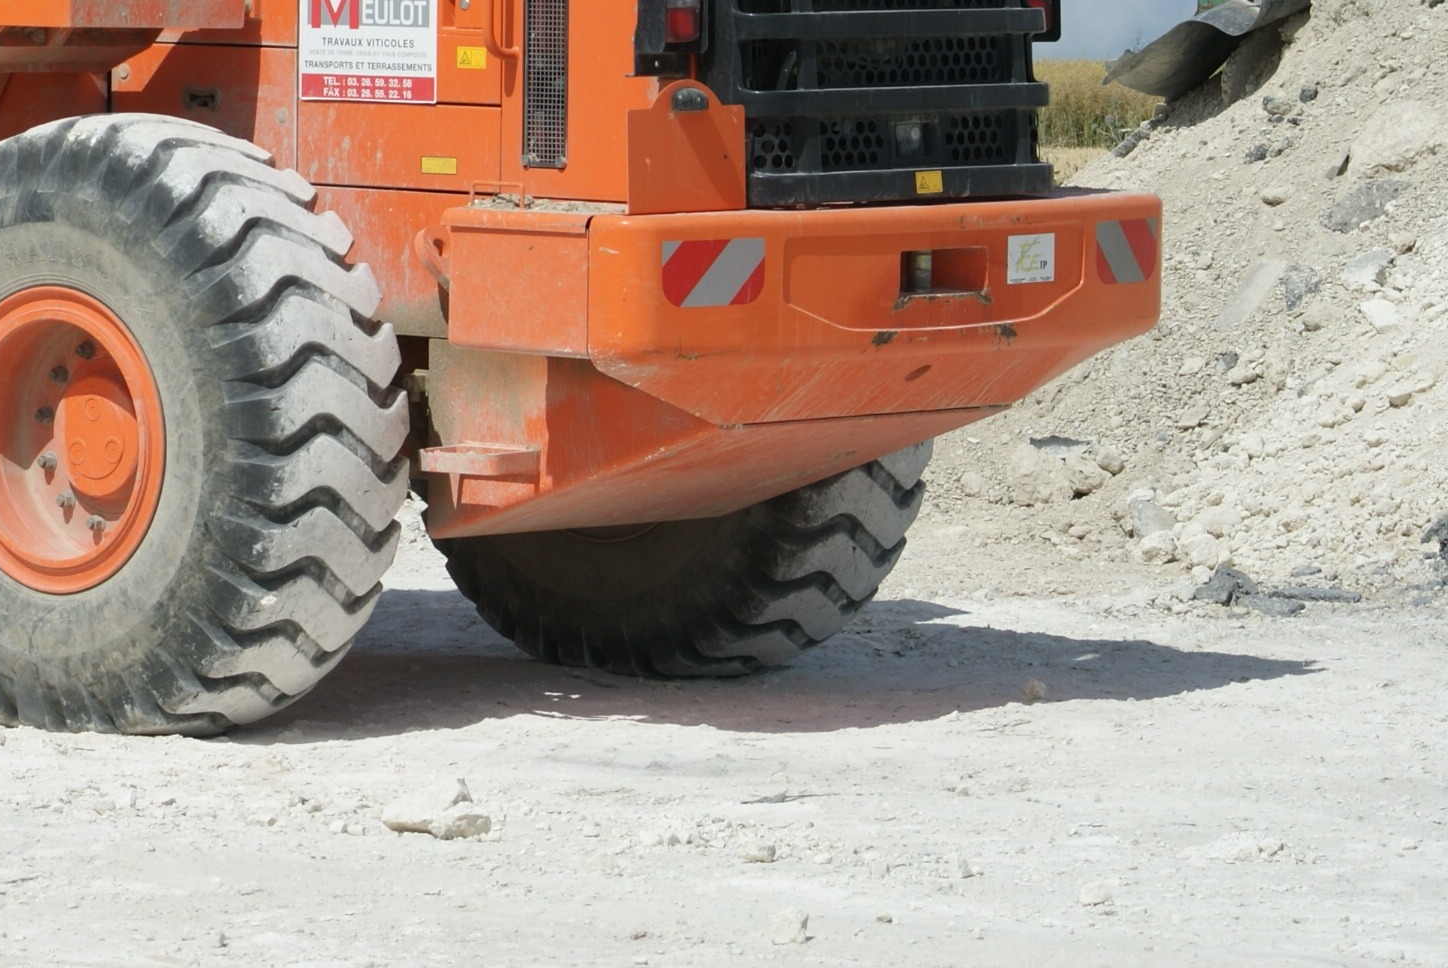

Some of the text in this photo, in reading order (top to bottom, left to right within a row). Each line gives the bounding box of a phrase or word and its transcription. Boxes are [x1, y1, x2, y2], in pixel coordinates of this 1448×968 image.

[322, 37, 415, 48] TRAVAUX VITICOLES
[304, 60, 432, 72] TRANSPORTS ET TERRASSEMENTS
[347, 77, 359, 86] 03.
[347, 88, 359, 97] 03.
[402, 90, 412, 99] 16
[1039, 260, 1048, 269] TP
